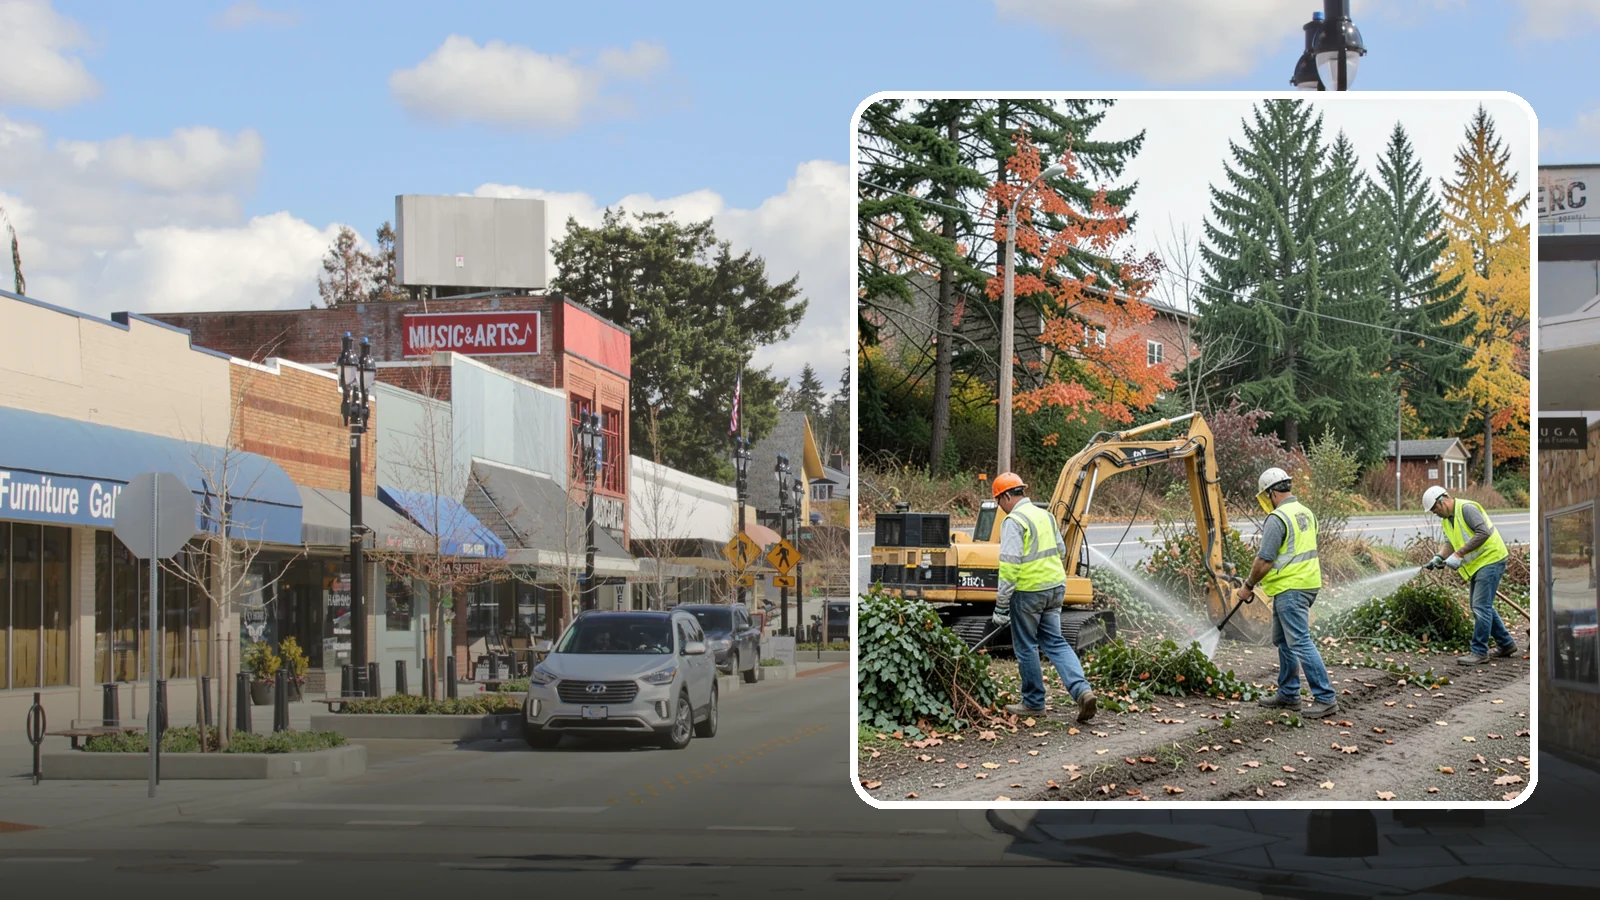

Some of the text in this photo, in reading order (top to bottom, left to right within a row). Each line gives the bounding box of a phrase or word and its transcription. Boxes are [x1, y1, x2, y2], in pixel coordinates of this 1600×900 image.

[409, 323, 519, 348] MUSIC&ARTS
[0, 471, 121, 519] Furniture Gal
